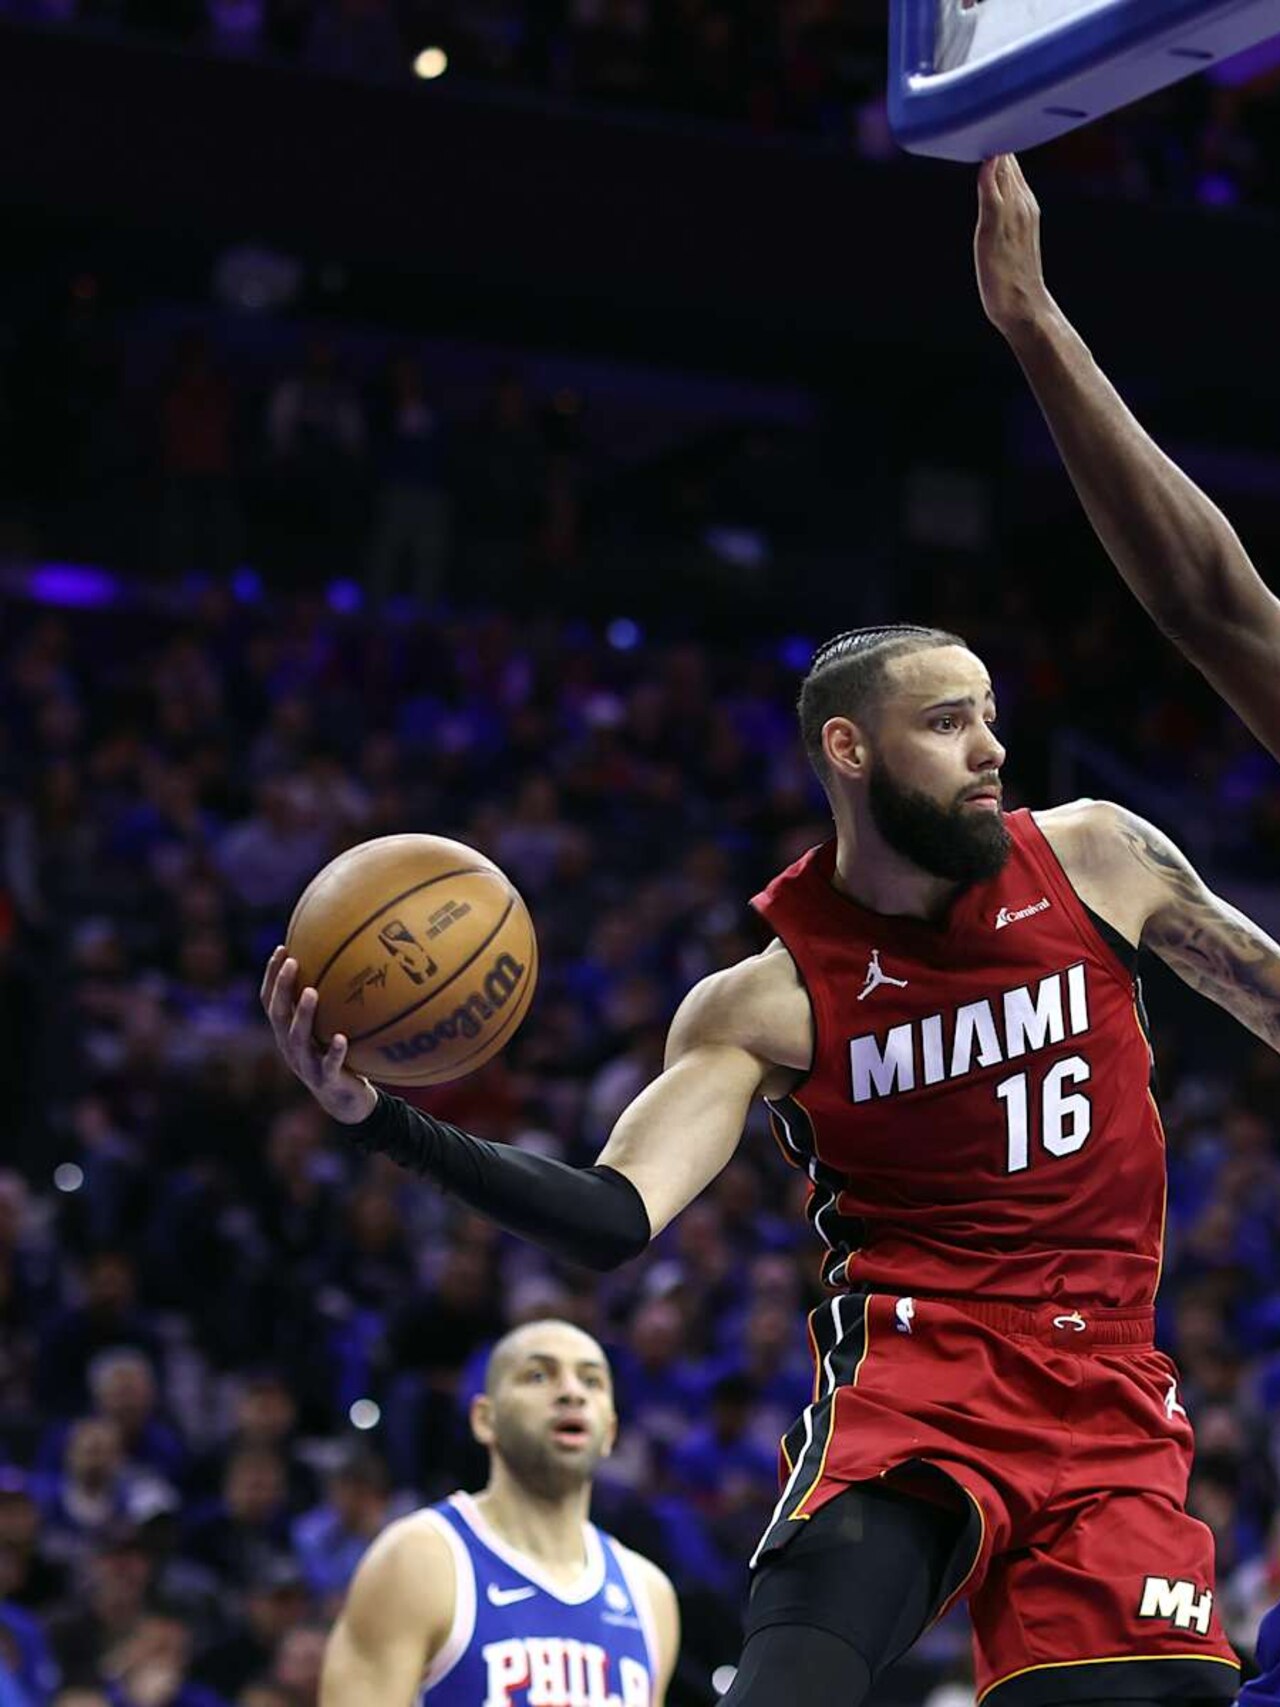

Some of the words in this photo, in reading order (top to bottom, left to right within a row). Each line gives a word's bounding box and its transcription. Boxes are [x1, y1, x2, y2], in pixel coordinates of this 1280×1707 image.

[1006, 896, 1051, 922] Carnival
[848, 964, 1090, 1104] MIAMI
[996, 1054, 1092, 1174] 16
